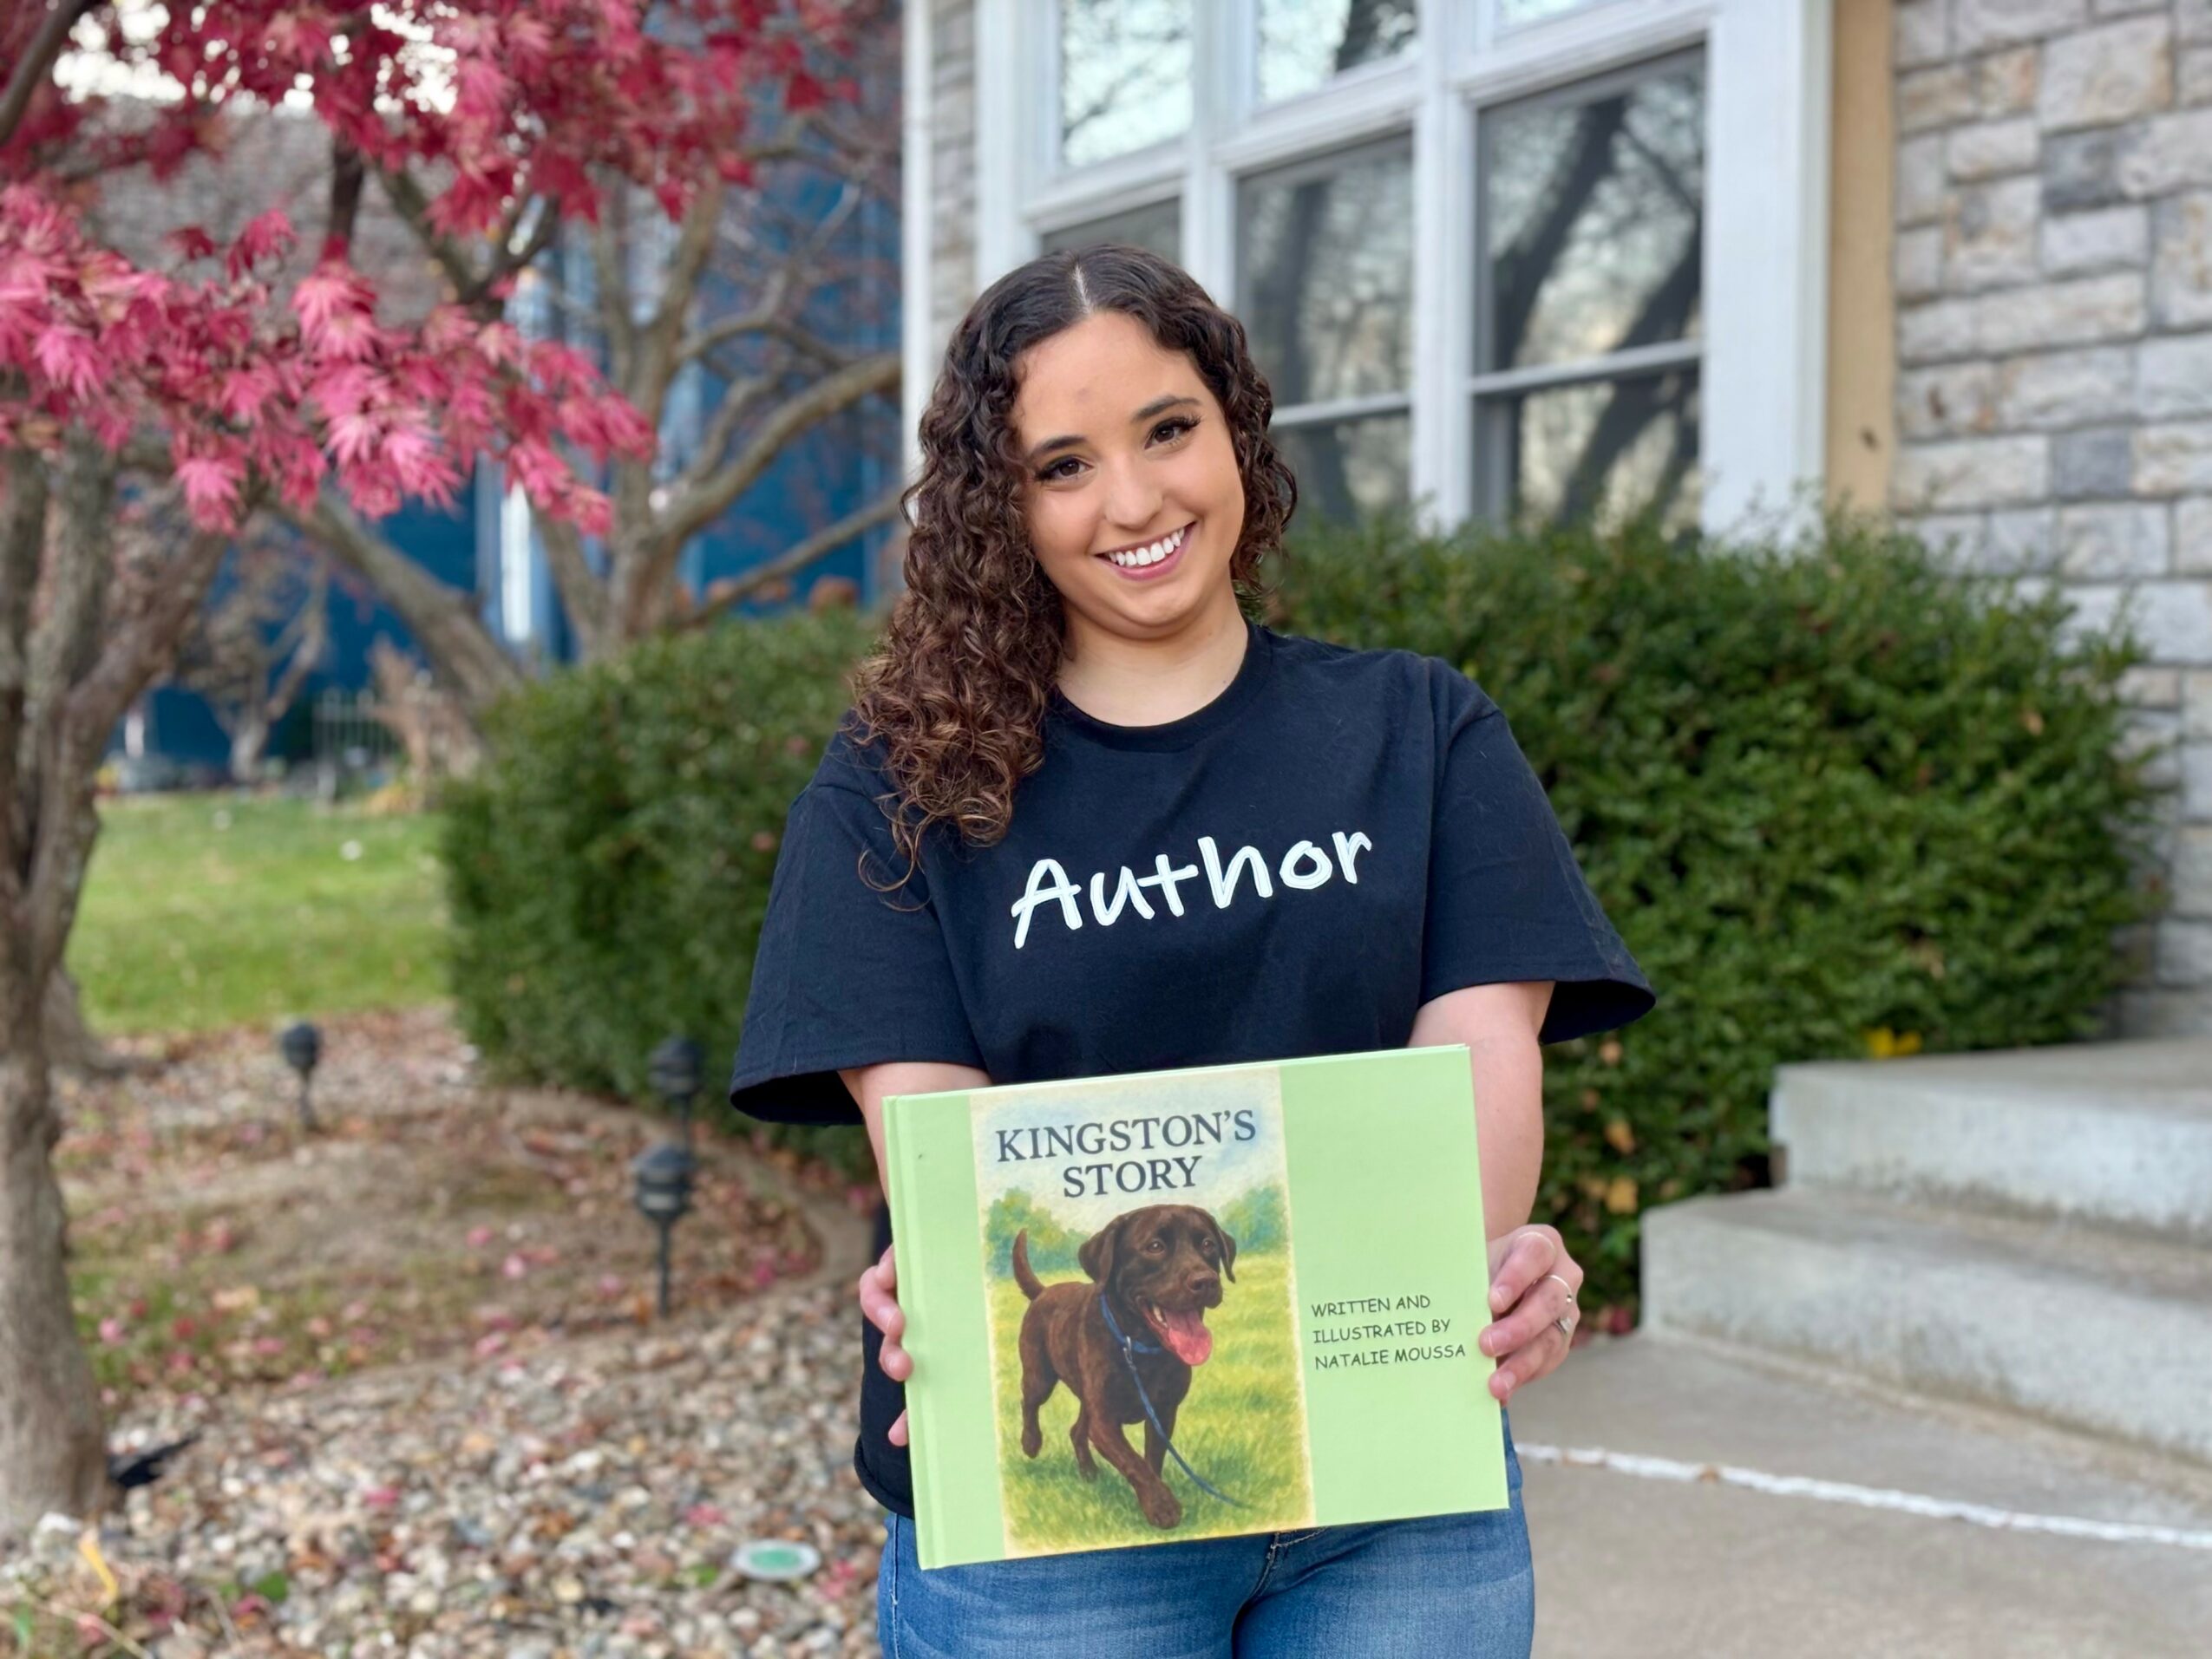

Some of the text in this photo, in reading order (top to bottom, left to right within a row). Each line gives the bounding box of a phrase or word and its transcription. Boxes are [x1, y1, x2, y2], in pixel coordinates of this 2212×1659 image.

[1011, 830, 1373, 950] Author
[995, 1109, 1257, 1163] KINGSTON’S
[1063, 1155, 1203, 1198] STORY
[1311, 1294, 1431, 1317] WRITTEN AND
[1312, 1318, 1451, 1343] ILLUSTRATED BY
[1315, 1344, 1466, 1370] NATALIE MOUSSA
